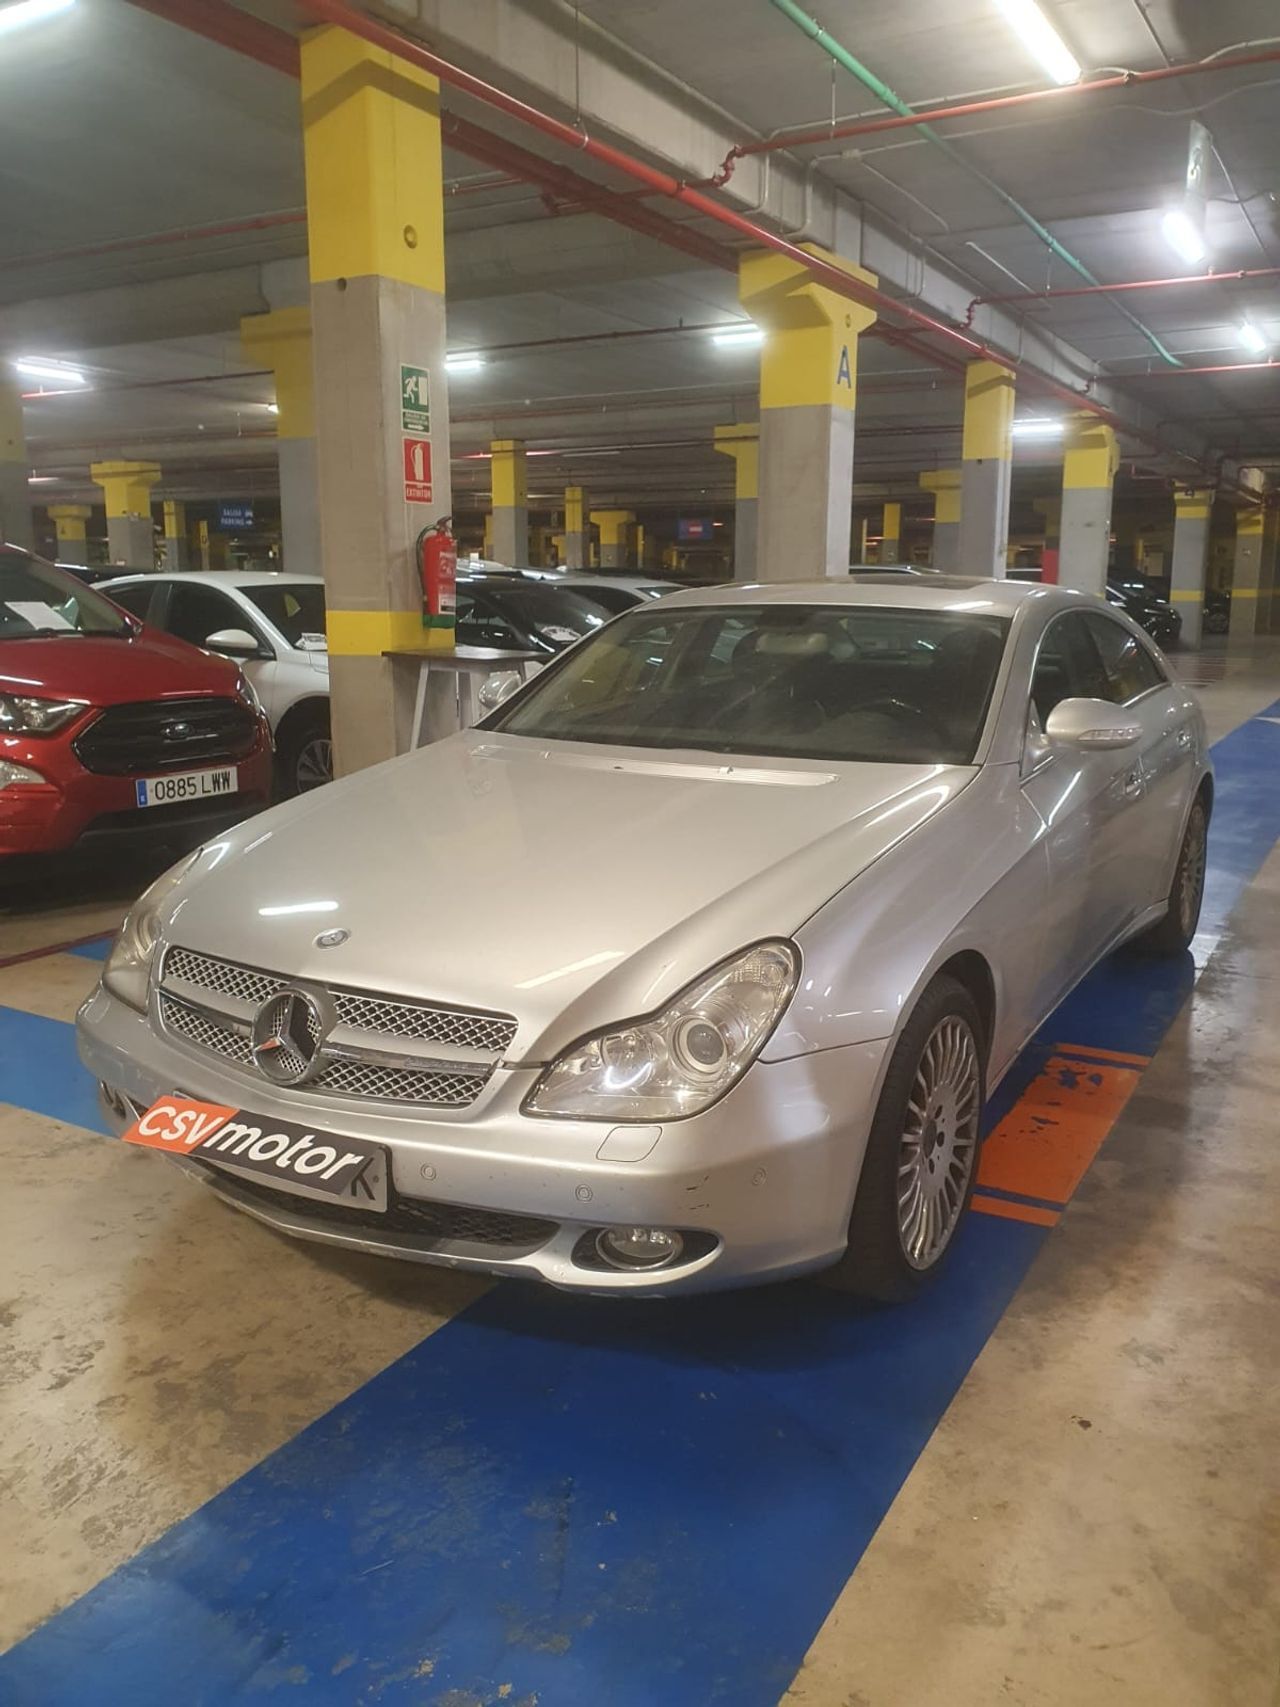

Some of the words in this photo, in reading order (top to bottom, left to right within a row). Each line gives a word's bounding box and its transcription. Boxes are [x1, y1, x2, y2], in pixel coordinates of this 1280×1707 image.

[836, 344, 852, 389] A
[154, 777, 197, 800] 0885
[201, 771, 231, 794] LWW
